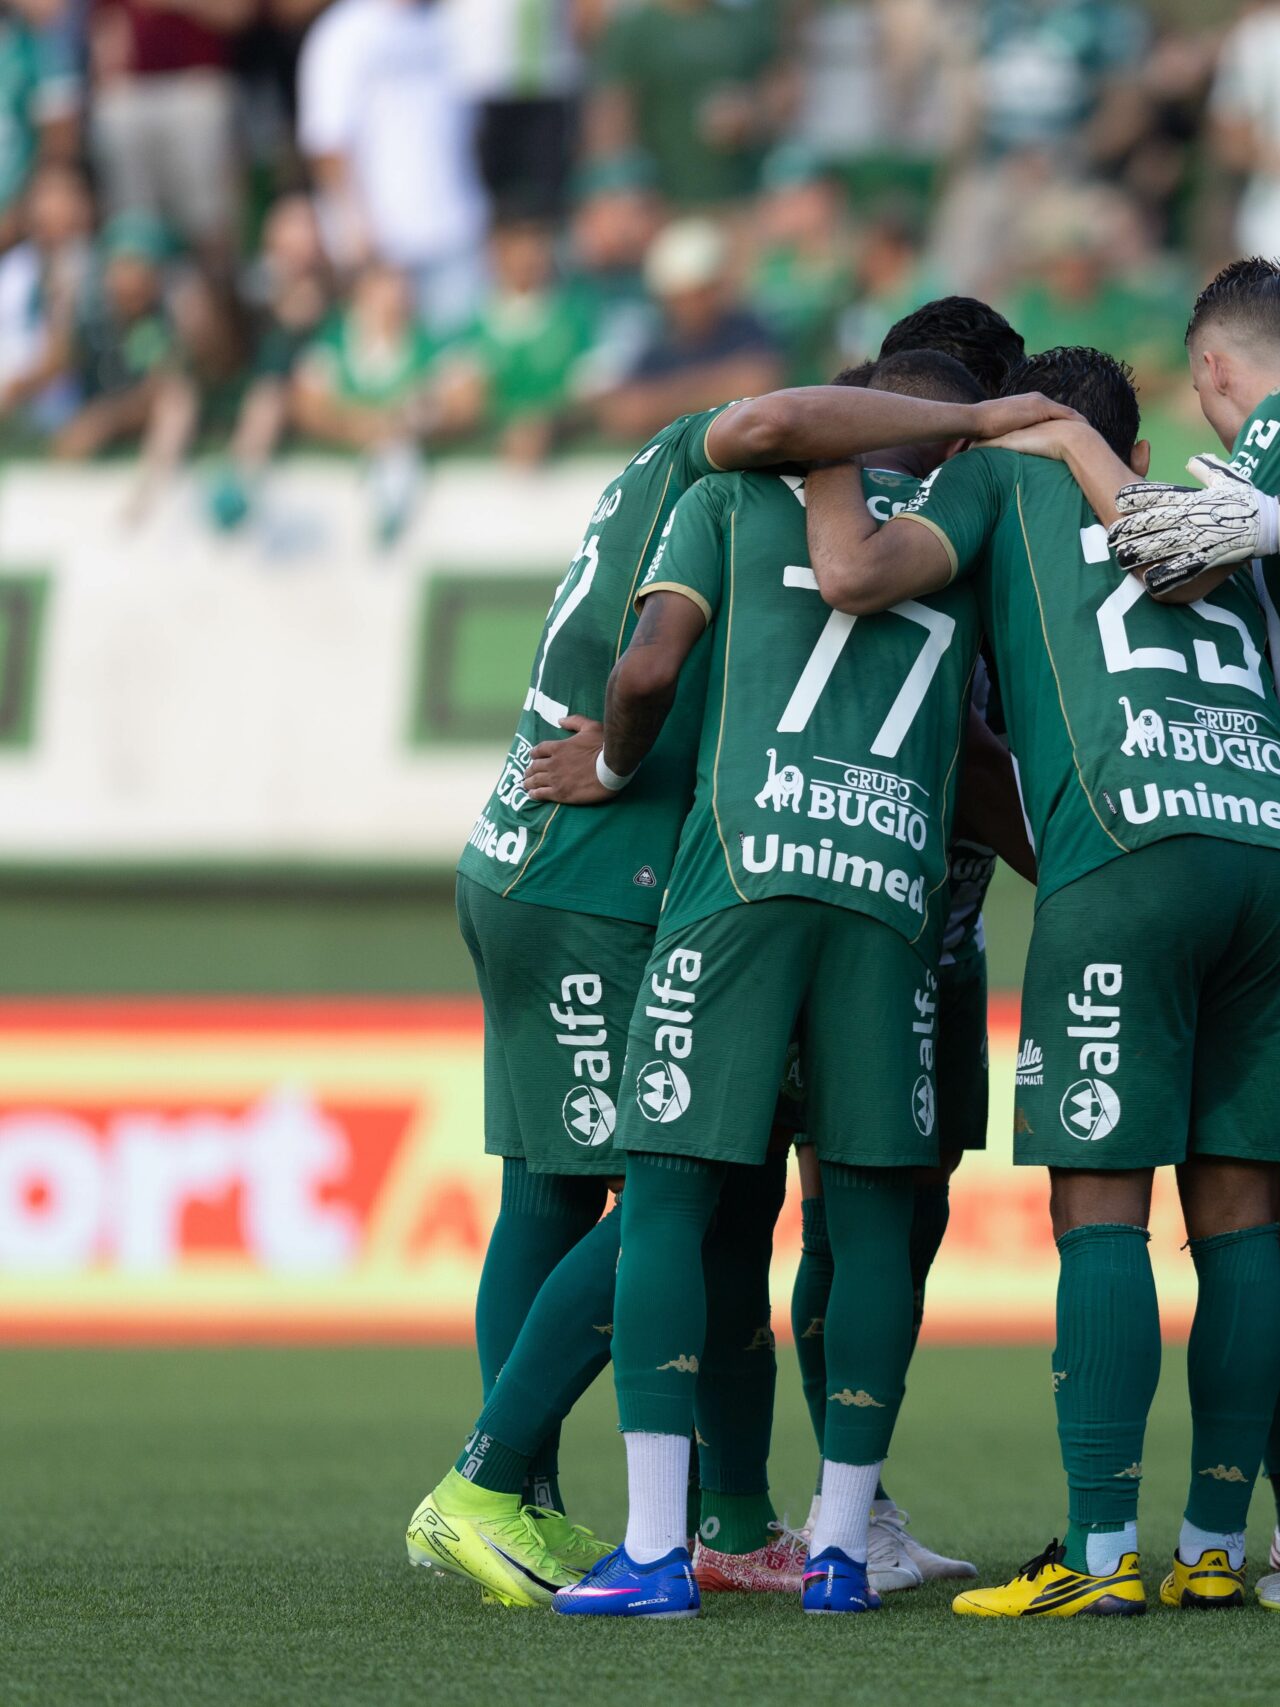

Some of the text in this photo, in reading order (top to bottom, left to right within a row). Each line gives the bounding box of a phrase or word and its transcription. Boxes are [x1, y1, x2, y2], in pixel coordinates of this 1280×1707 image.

[776, 564, 957, 758] 77
[1194, 709, 1257, 734] GRUPO
[807, 784, 927, 851] BUGIO
[844, 769, 910, 800] GRUPO
[742, 834, 925, 914] Unimed
[550, 973, 611, 1082] alfa
[646, 948, 702, 1059] alfa
[911, 968, 938, 1071] alfa
[1066, 963, 1123, 1075] alfa
[1023, 1074, 1044, 1085] MALTE
